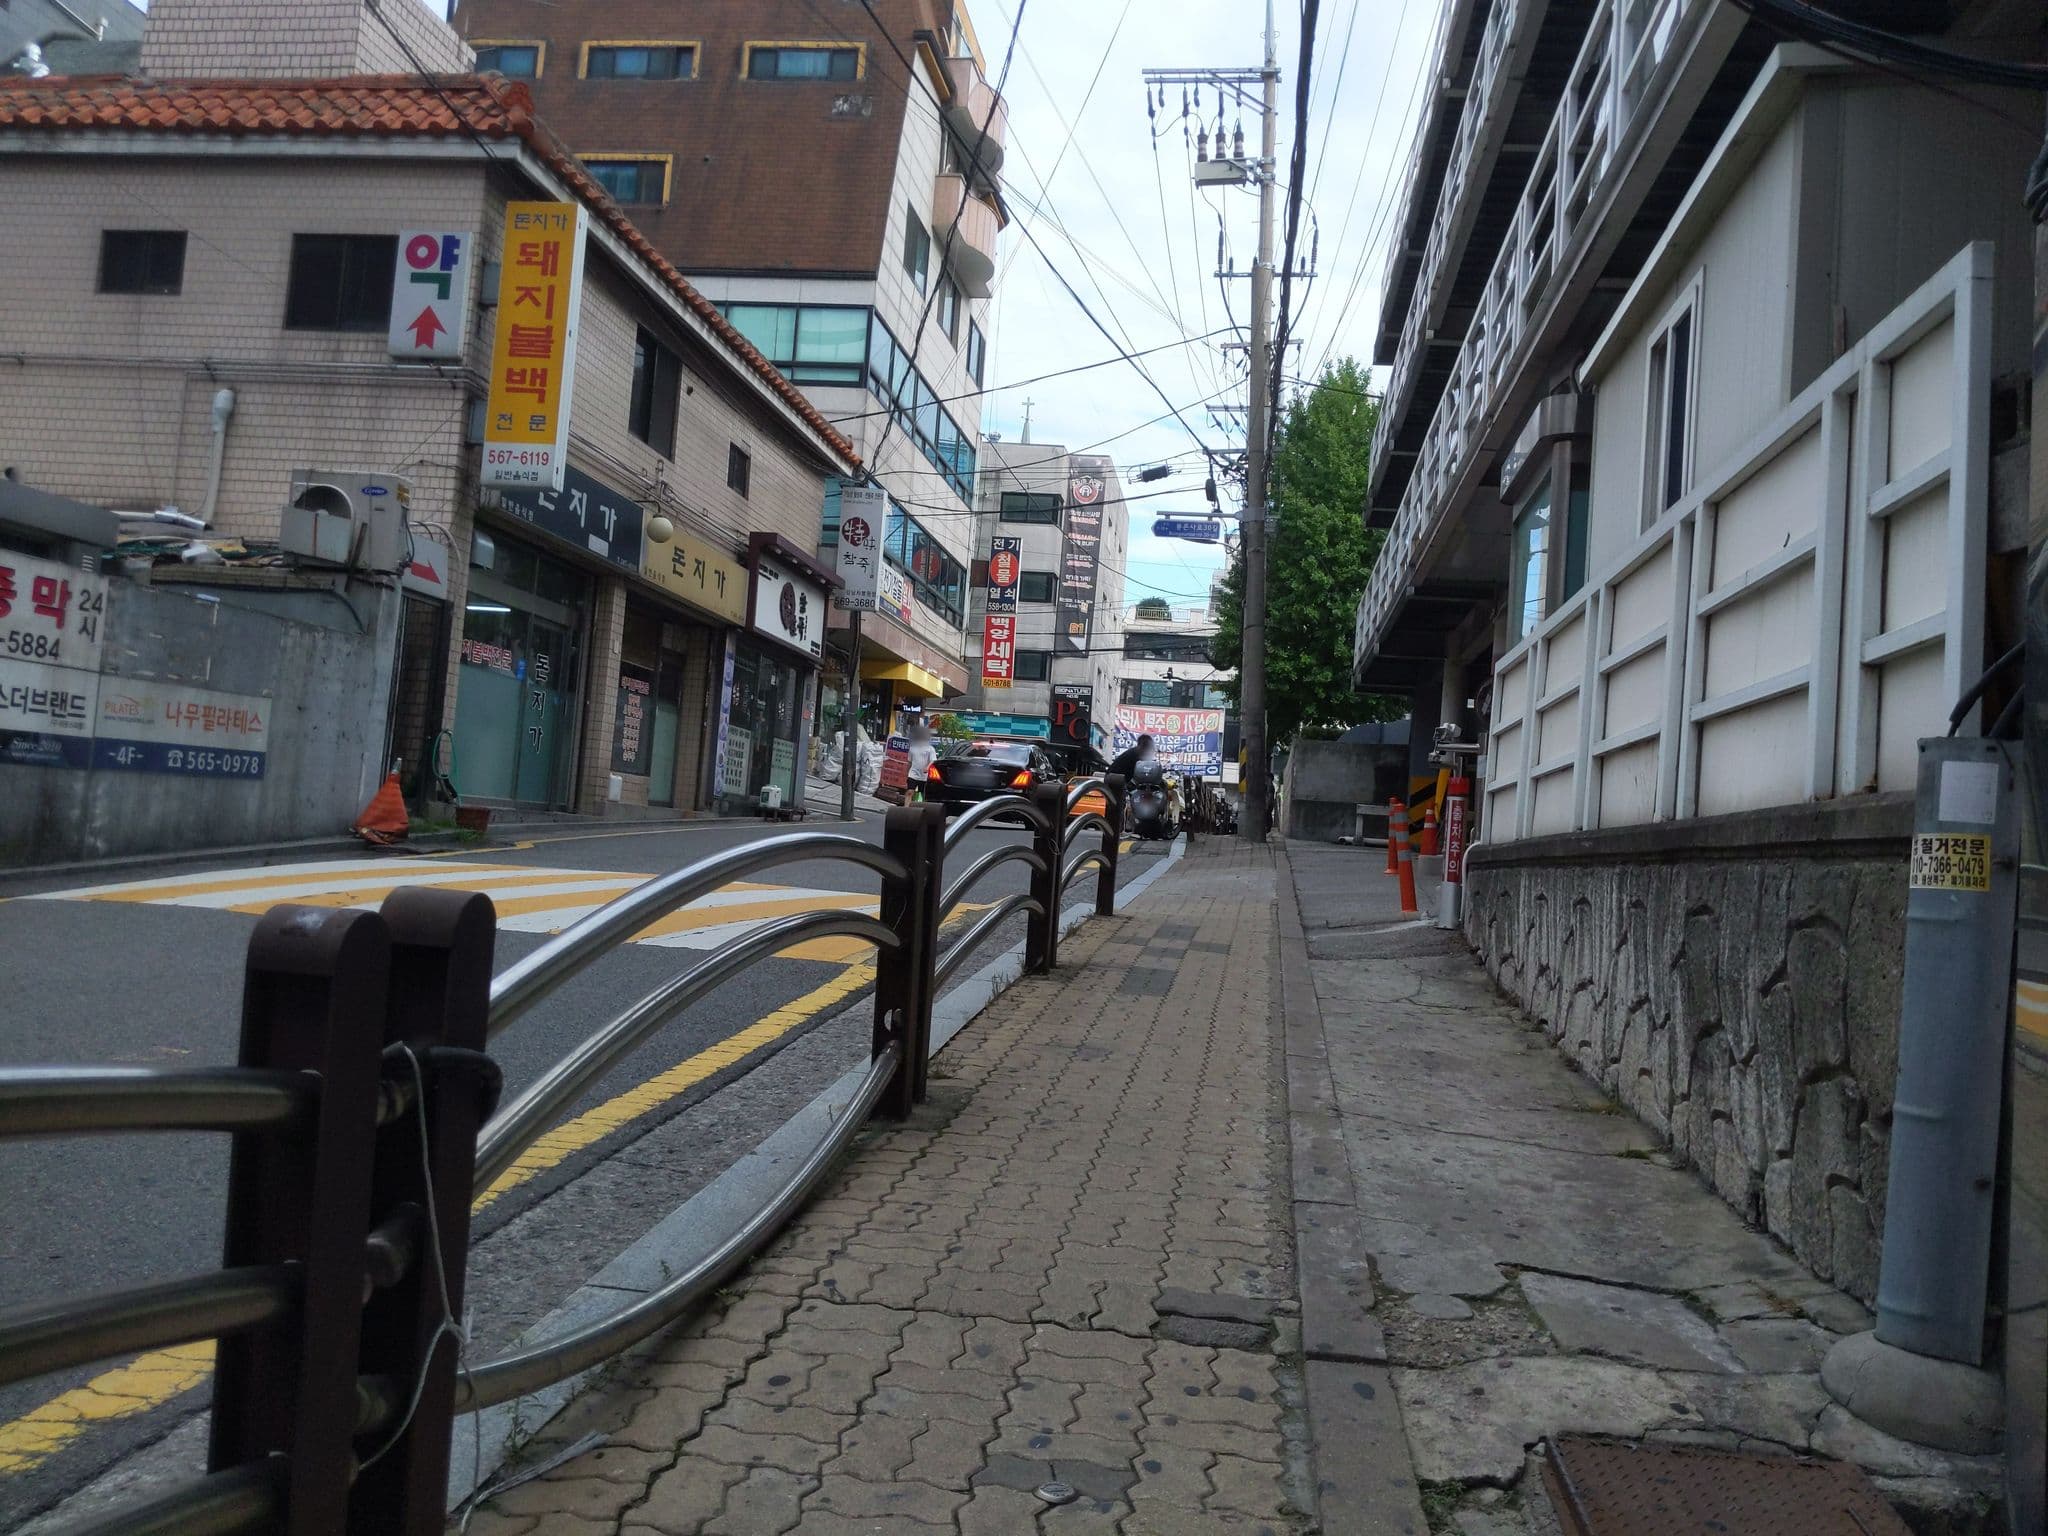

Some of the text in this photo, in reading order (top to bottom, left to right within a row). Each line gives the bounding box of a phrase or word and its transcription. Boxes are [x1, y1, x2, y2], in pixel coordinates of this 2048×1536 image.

[405, 234, 461, 300] 약
[505, 241, 561, 403] 돼지불백
[496, 412, 546, 432] 전문
[488, 449, 549, 466] 567-6119
[538, 488, 618, 543] 지가
[993, 538, 1020, 552] 전기
[672, 545, 726, 599] 돈지가
[79, 589, 103, 616] 24
[79, 616, 97, 643] 시
[165, 701, 263, 735] 나무필라테스
[529, 653, 550, 755] 돈지가
[187, 751, 259, 774] 565-0978
[1448, 806, 1462, 875] 출차주의
[1921, 838, 1985, 856] 철거전문
